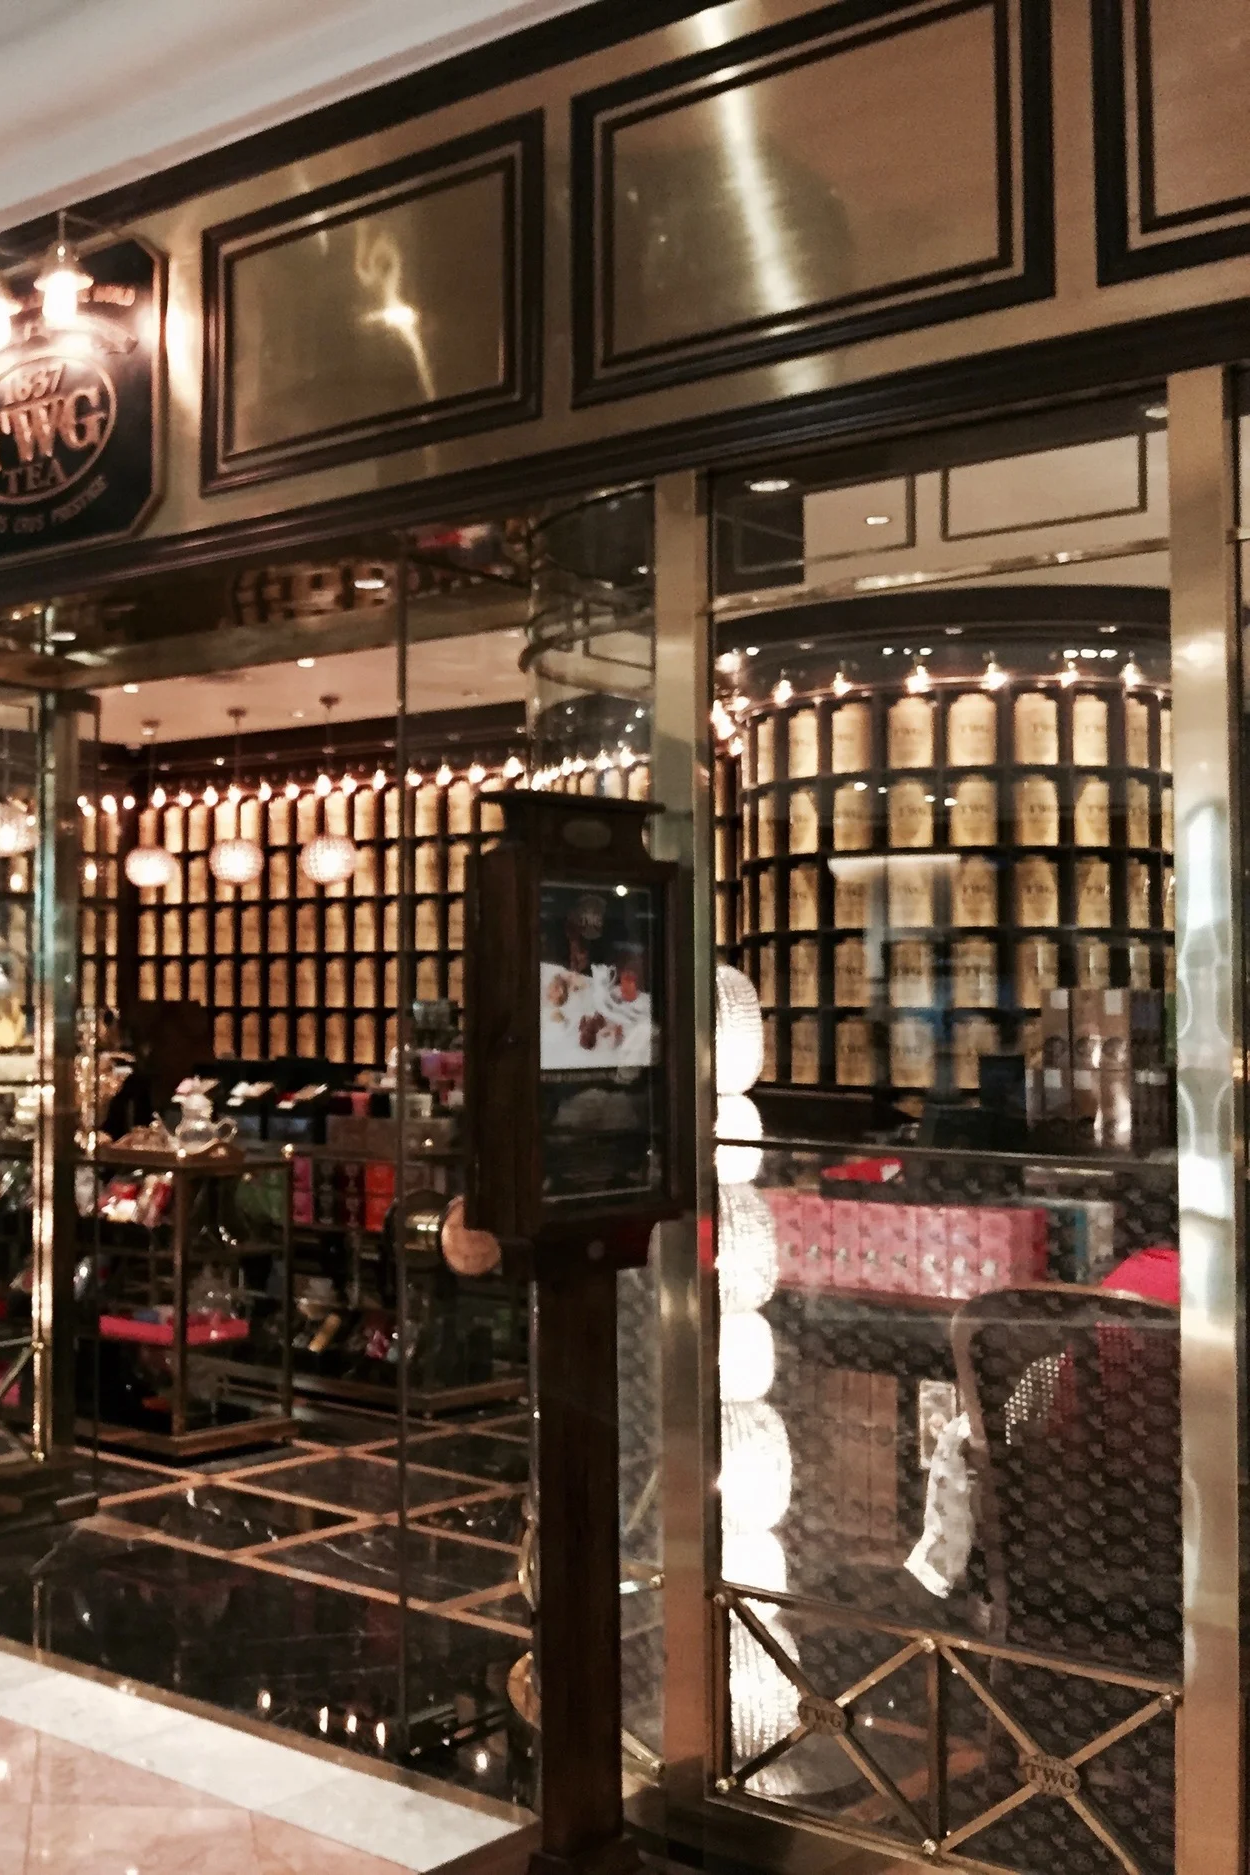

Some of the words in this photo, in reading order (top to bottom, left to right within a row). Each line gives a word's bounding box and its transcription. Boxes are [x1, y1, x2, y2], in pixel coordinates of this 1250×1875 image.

[2, 458, 67, 494] TEA
[799, 1705, 842, 1728] TWG
[1023, 1762, 1076, 1789] TWG
